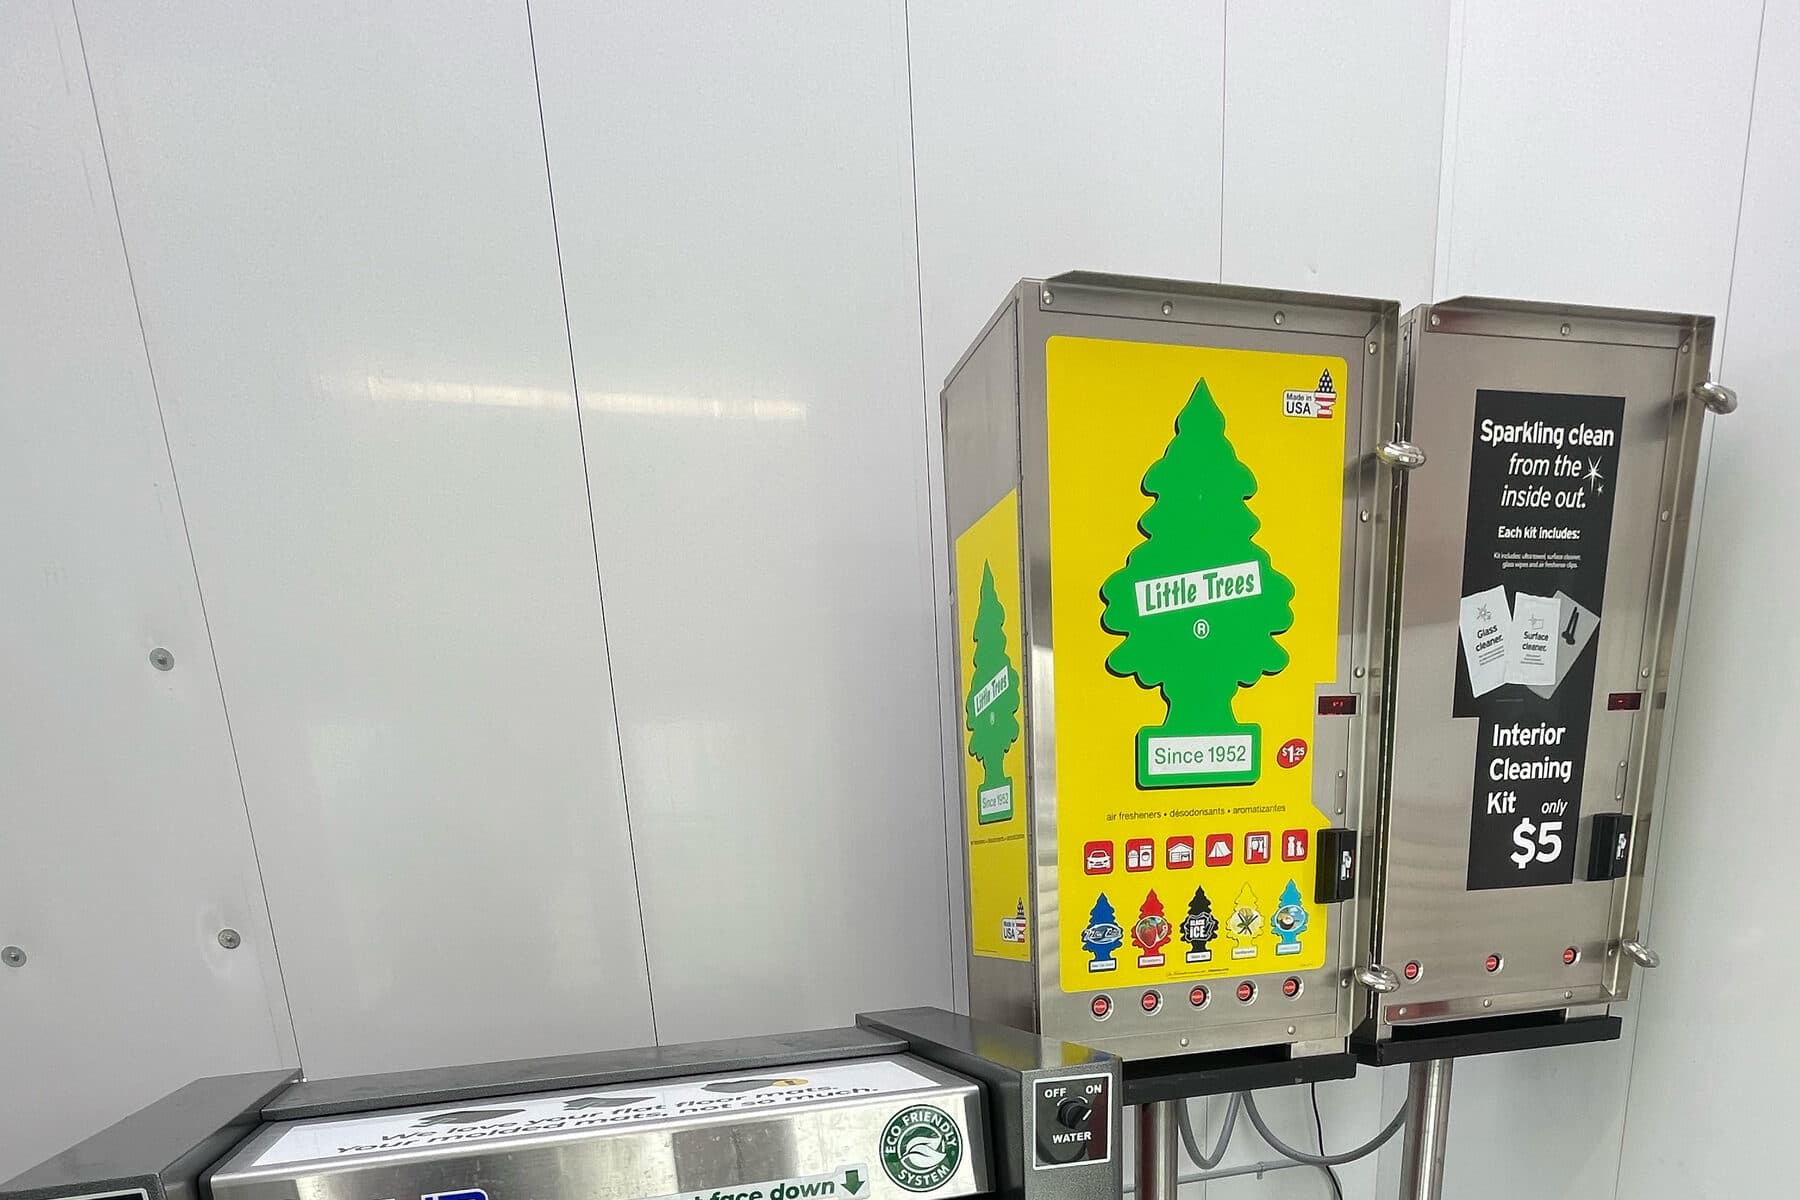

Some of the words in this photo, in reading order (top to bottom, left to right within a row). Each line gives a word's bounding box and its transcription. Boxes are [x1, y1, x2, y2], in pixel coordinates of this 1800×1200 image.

[1286, 392, 1305, 401] Made
[1286, 401, 1311, 415] USA
[1480, 419, 1564, 449] Sparkling
[1569, 423, 1614, 446] clean
[1508, 452, 1550, 476] from
[1554, 454, 1582, 477] the
[1501, 484, 1551, 508] inside
[1554, 487, 1586, 509] out.
[1498, 525, 1522, 540] Each
[1524, 526, 1537, 540] kit
[1538, 527, 1581, 541] includes:
[1145, 578, 1197, 612] Little
[1202, 572, 1255, 600] Trees
[1477, 625, 1498, 639] Glass
[1523, 631, 1549, 642] Surface
[1475, 634, 1504, 652] cleaner.
[1492, 722, 1566, 747] Interior
[1154, 746, 1204, 765] Since
[1207, 745, 1247, 764] 1952
[1489, 756, 1573, 783] Cleaning
[1487, 792, 1517, 815] Kit
[1541, 798, 1569, 816] only
[1106, 813, 1117, 821] air
[1119, 811, 1162, 820] fresheners
[1510, 817, 1563, 869] $5
[1003, 927, 1016, 940] USA
[1044, 1087, 1067, 1098] OFF
[1085, 1084, 1102, 1094] ON
[337, 1139, 420, 1152] your
[427, 1121, 568, 1143] molded
[679, 1103, 736, 1114] not
[381, 1130, 436, 1142] We
[448, 1121, 518, 1134] love
[525, 1111, 605, 1123] your
[615, 1103, 668, 1115] flat
[676, 1094, 747, 1107] floor
[885, 1125, 901, 1154] ECO
[901, 1110, 957, 1147] FRIENDLY
[1052, 1131, 1092, 1144] WATER
[898, 1164, 950, 1186] SYSTEM
